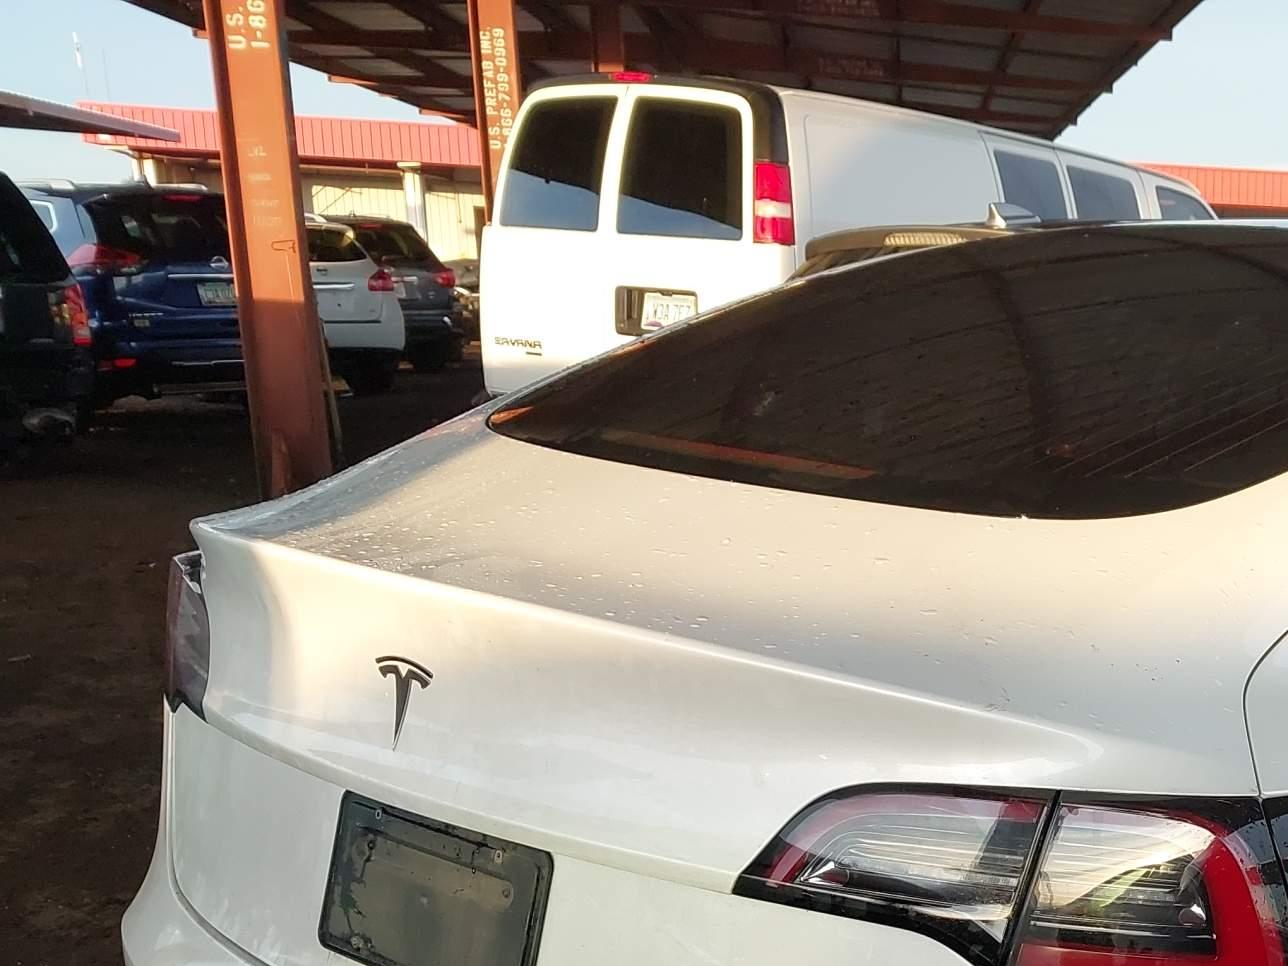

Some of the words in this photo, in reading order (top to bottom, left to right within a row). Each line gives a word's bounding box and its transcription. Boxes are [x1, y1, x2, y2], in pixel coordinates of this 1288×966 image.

[226, 6, 246, 49] U.S.
[480, 27, 492, 53] INC.
[482, 61, 498, 115] PREFAB
[488, 123, 501, 149] U.S.
